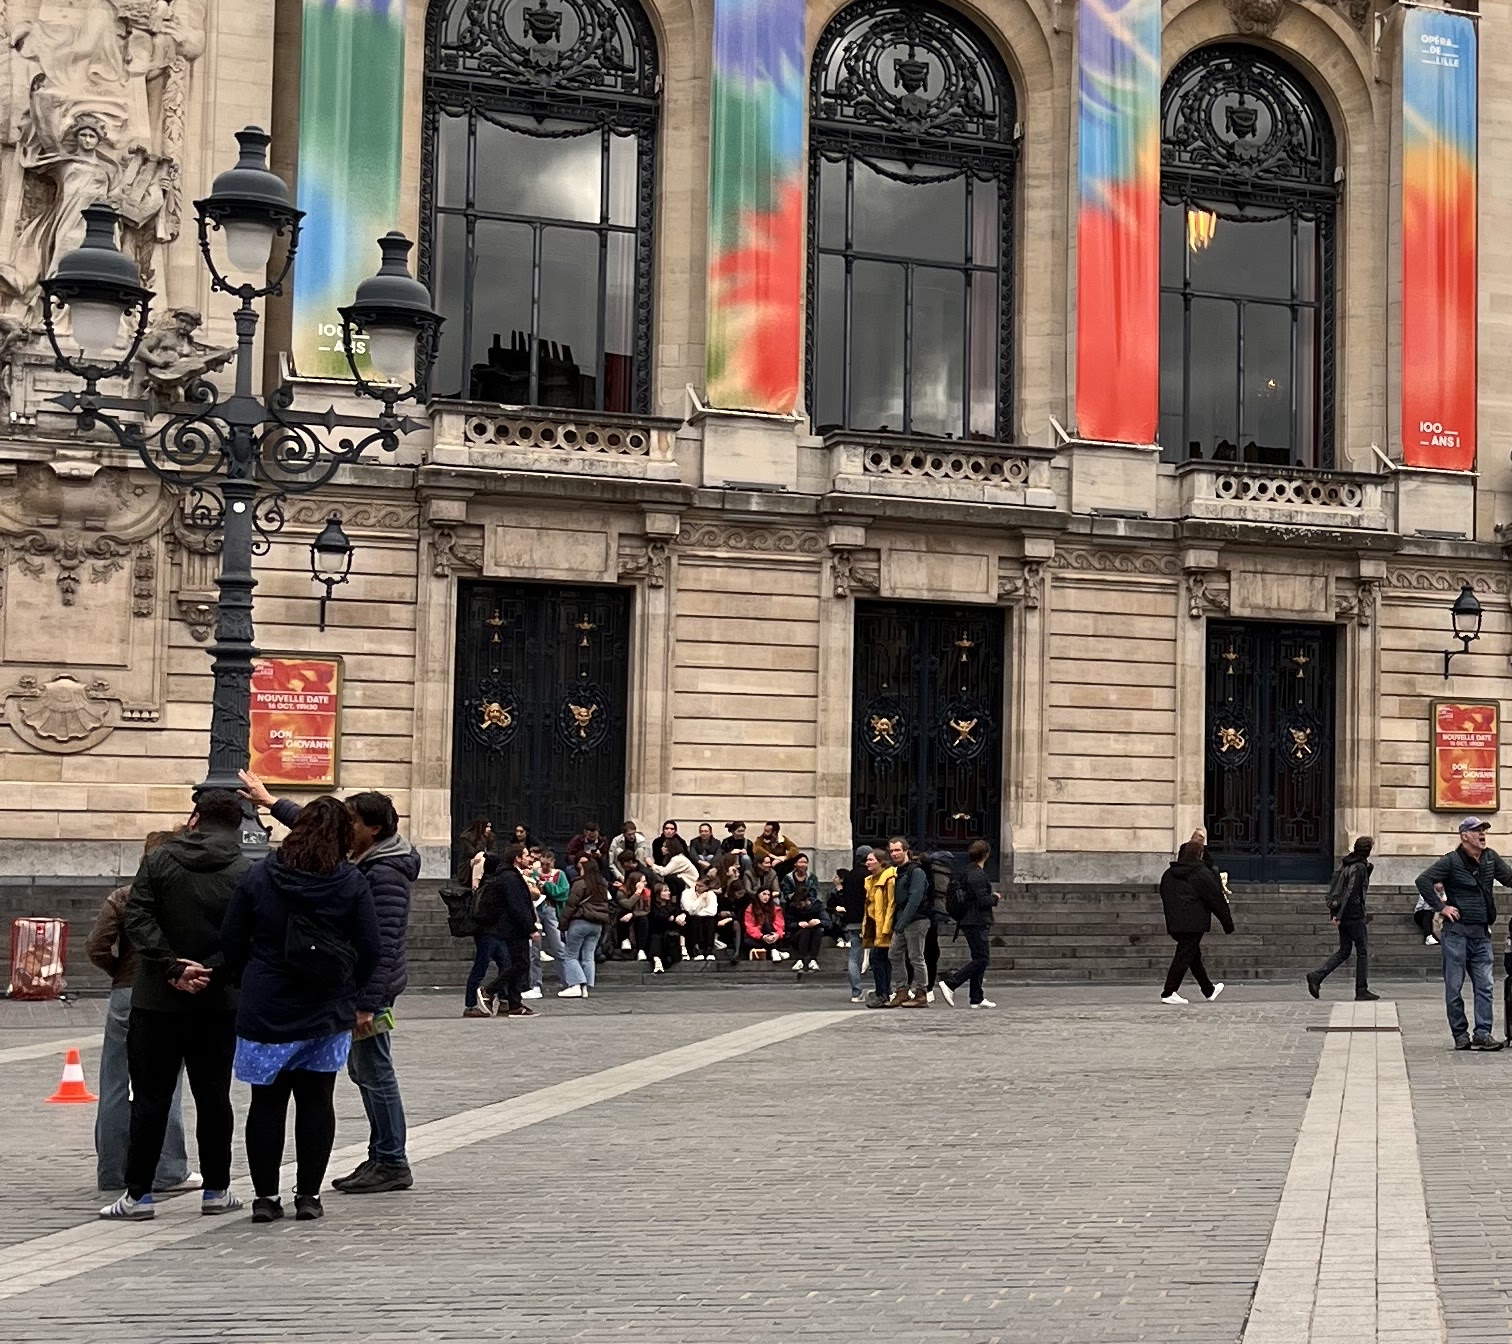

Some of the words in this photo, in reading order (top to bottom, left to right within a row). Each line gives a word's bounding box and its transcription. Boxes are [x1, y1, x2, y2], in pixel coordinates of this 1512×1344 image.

[1429, 45, 1442, 56] DE
[1419, 421, 1443, 434] 100
[257, 694, 305, 703] NOUVELLE
[306, 695, 329, 704] DATE
[269, 729, 293, 739] DON
[285, 739, 333, 749] GIOVANNI
